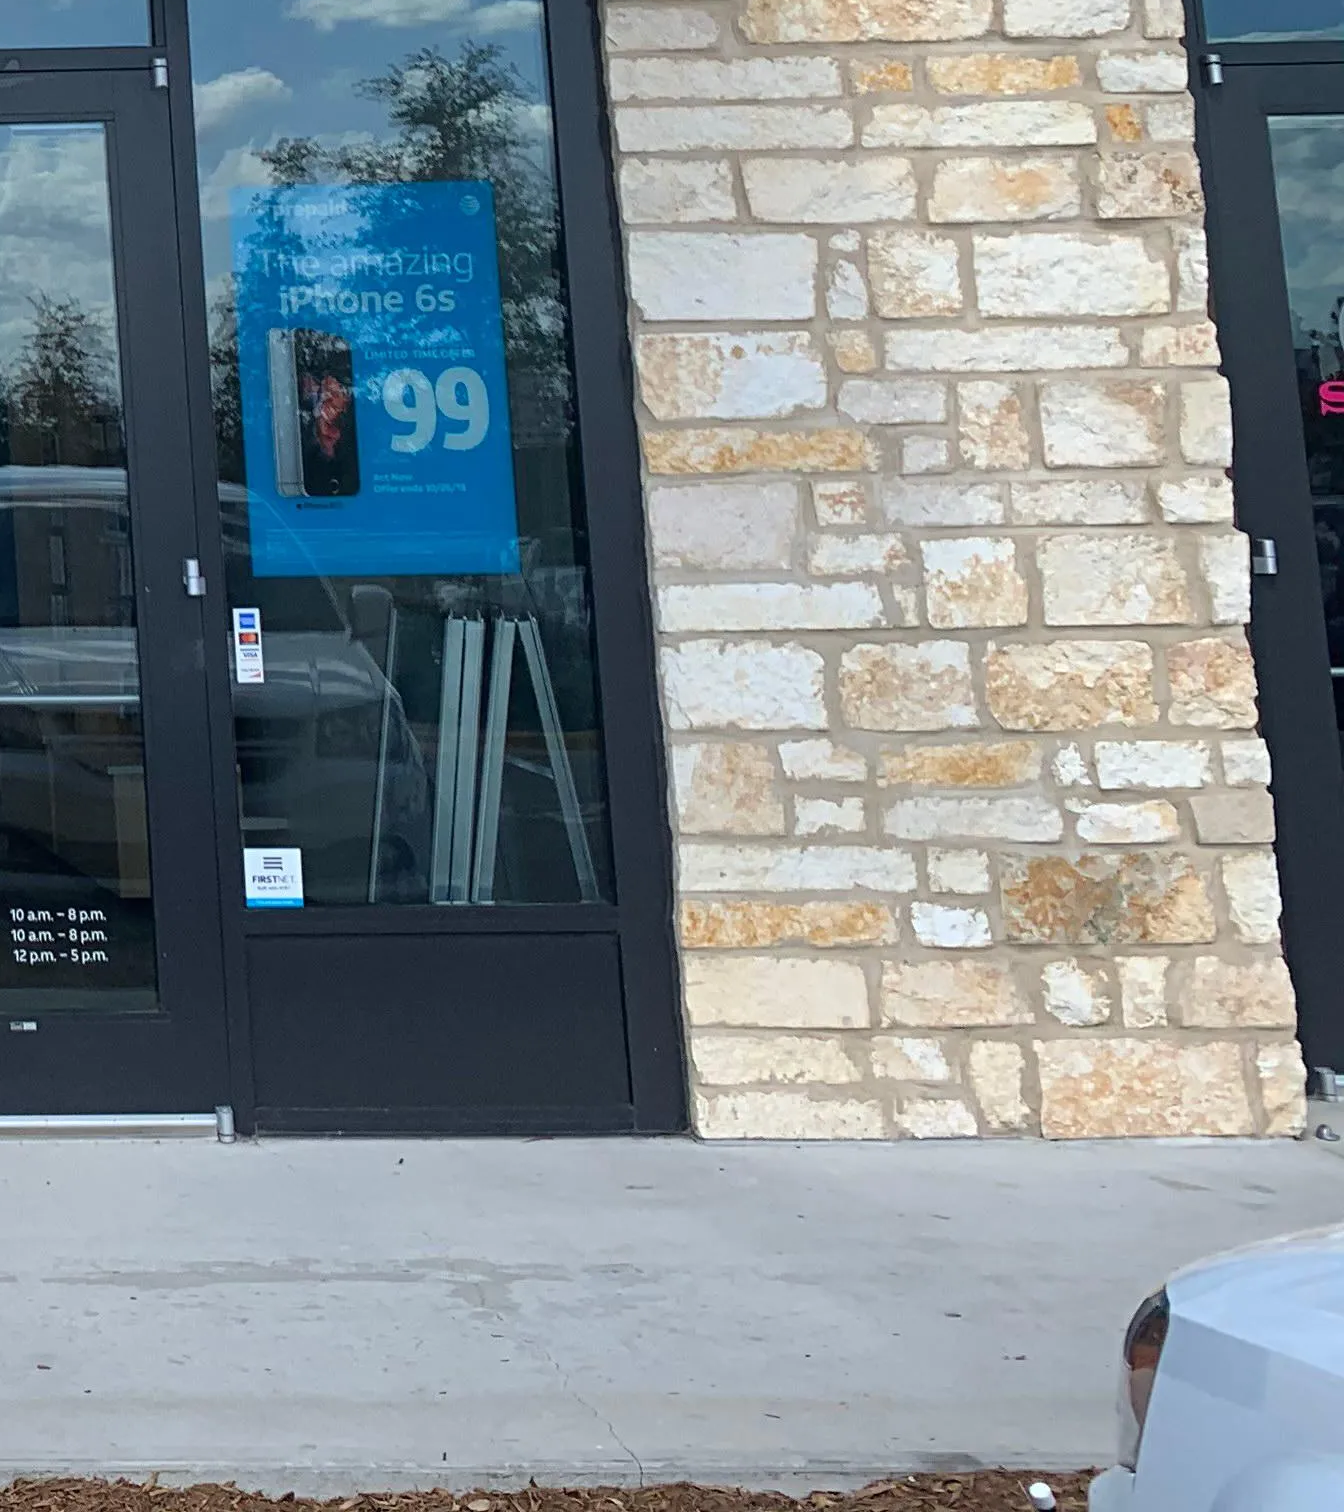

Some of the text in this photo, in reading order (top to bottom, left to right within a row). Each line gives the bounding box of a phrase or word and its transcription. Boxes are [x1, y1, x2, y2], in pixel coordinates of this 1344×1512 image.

[330, 246, 474, 283] amazing
[279, 284, 456, 316] iPhone 6s
[9, 908, 25, 922] 10
[68, 907, 77, 922] 8
[10, 928, 26, 942] 10
[68, 928, 78, 942] 8
[13, 949, 27, 962] 12
[70, 948, 79, 962] 5
